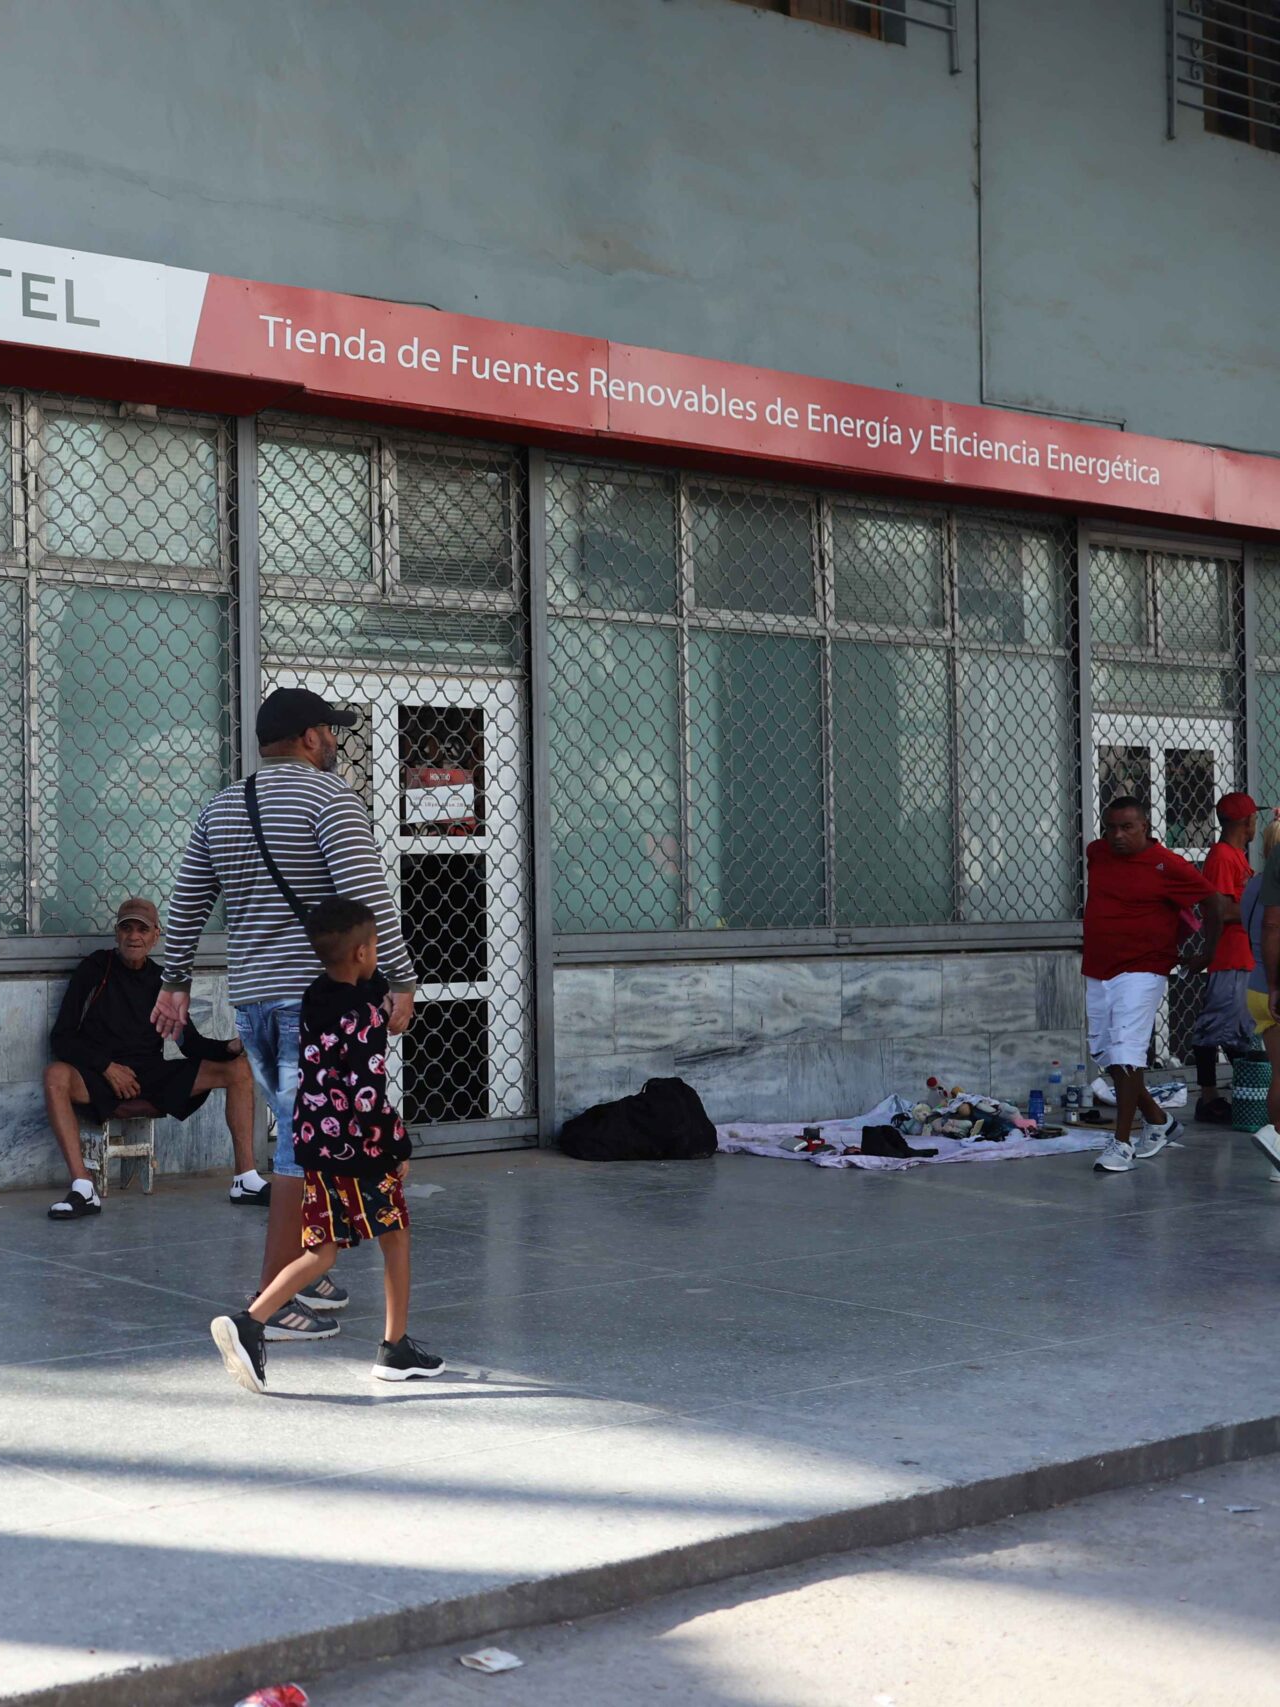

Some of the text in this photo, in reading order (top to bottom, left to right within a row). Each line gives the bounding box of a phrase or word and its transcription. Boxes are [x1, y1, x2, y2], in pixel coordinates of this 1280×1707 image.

[259, 313, 1161, 487] Tienda de Fuentes Renovables de Energía y Eficiencia Energética
